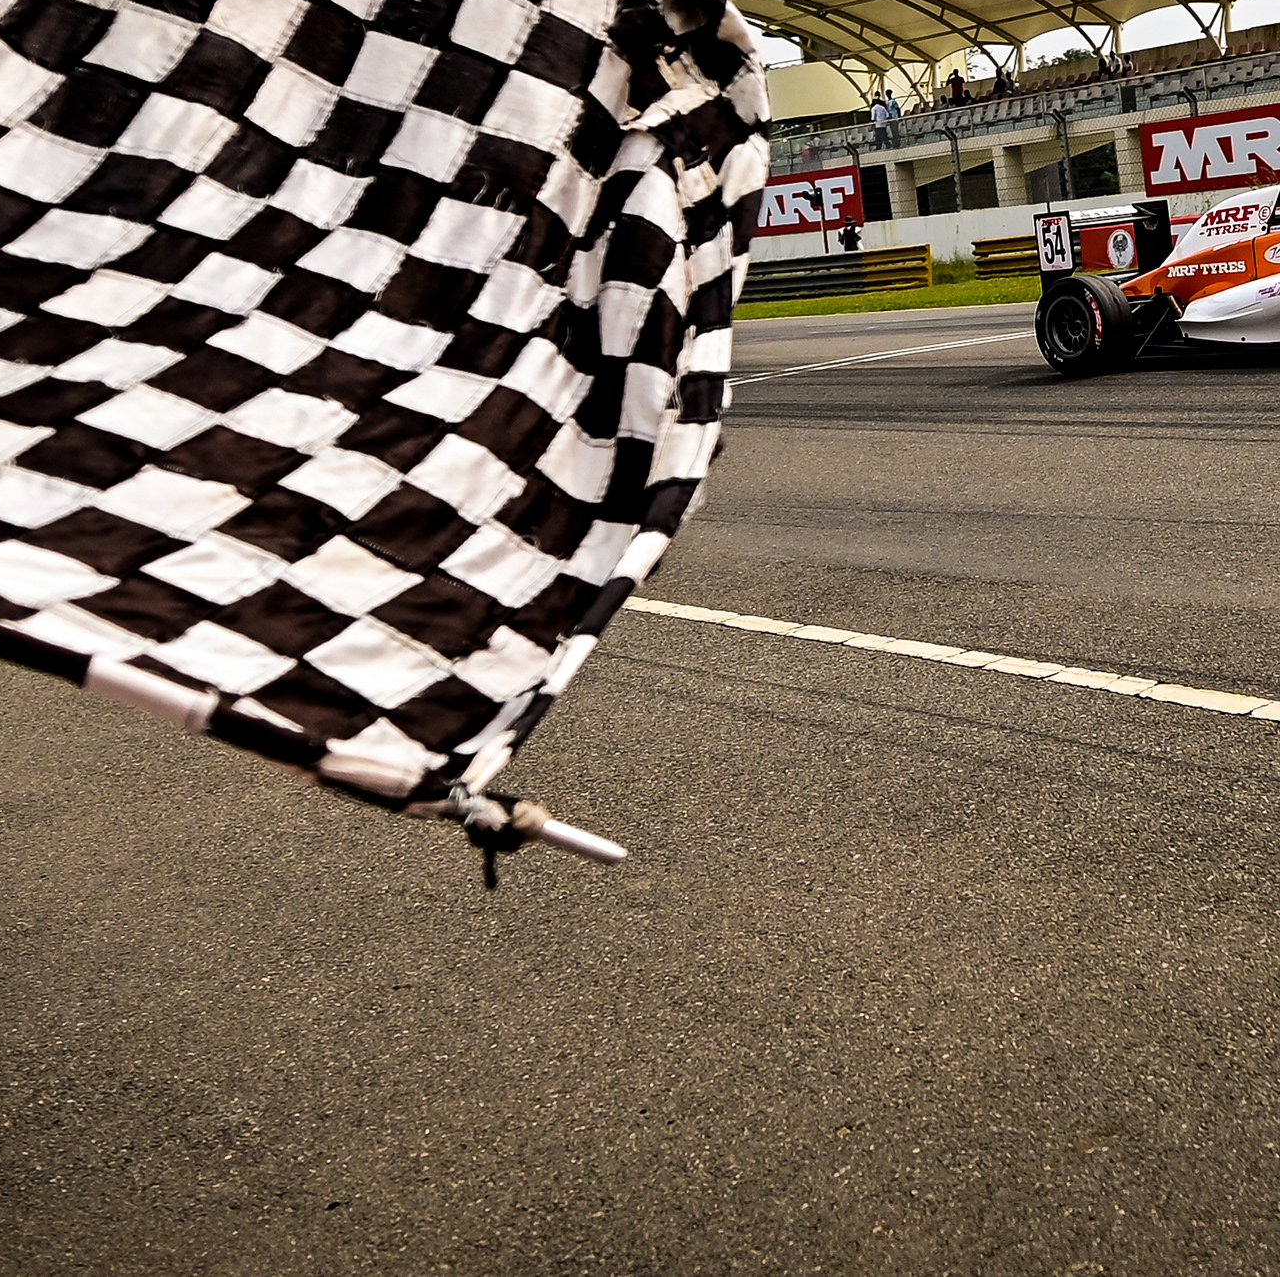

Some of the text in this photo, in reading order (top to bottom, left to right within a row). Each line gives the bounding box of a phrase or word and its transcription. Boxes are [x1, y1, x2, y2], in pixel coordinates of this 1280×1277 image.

[1201, 204, 1260, 228] MRF
[1042, 225, 1066, 264] 54
[1168, 261, 1247, 278] MRF TYRES
